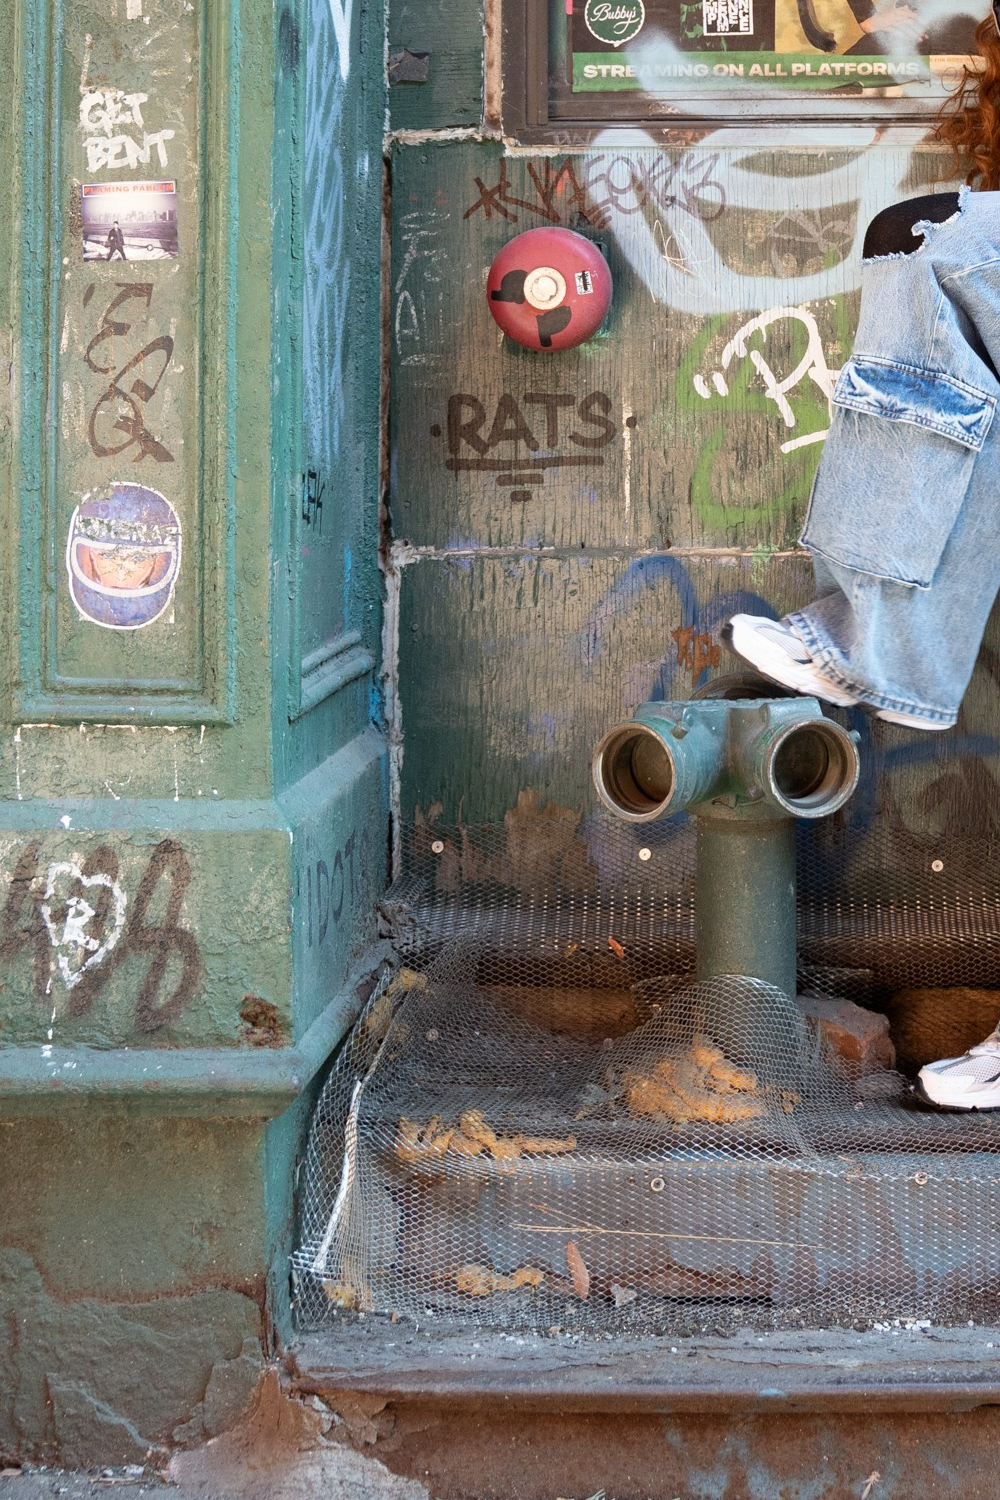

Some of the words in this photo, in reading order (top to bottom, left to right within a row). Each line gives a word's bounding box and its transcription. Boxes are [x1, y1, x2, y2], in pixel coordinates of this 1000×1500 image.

[589, 2, 641, 35] Bubby's
[583, 63, 709, 79] STREAMING
[713, 62, 745, 78] ON
[749, 62, 792, 77] ALL
[795, 60, 921, 76] PLATFORMS
[79, 89, 149, 138] GET
[82, 129, 176, 173] BENT
